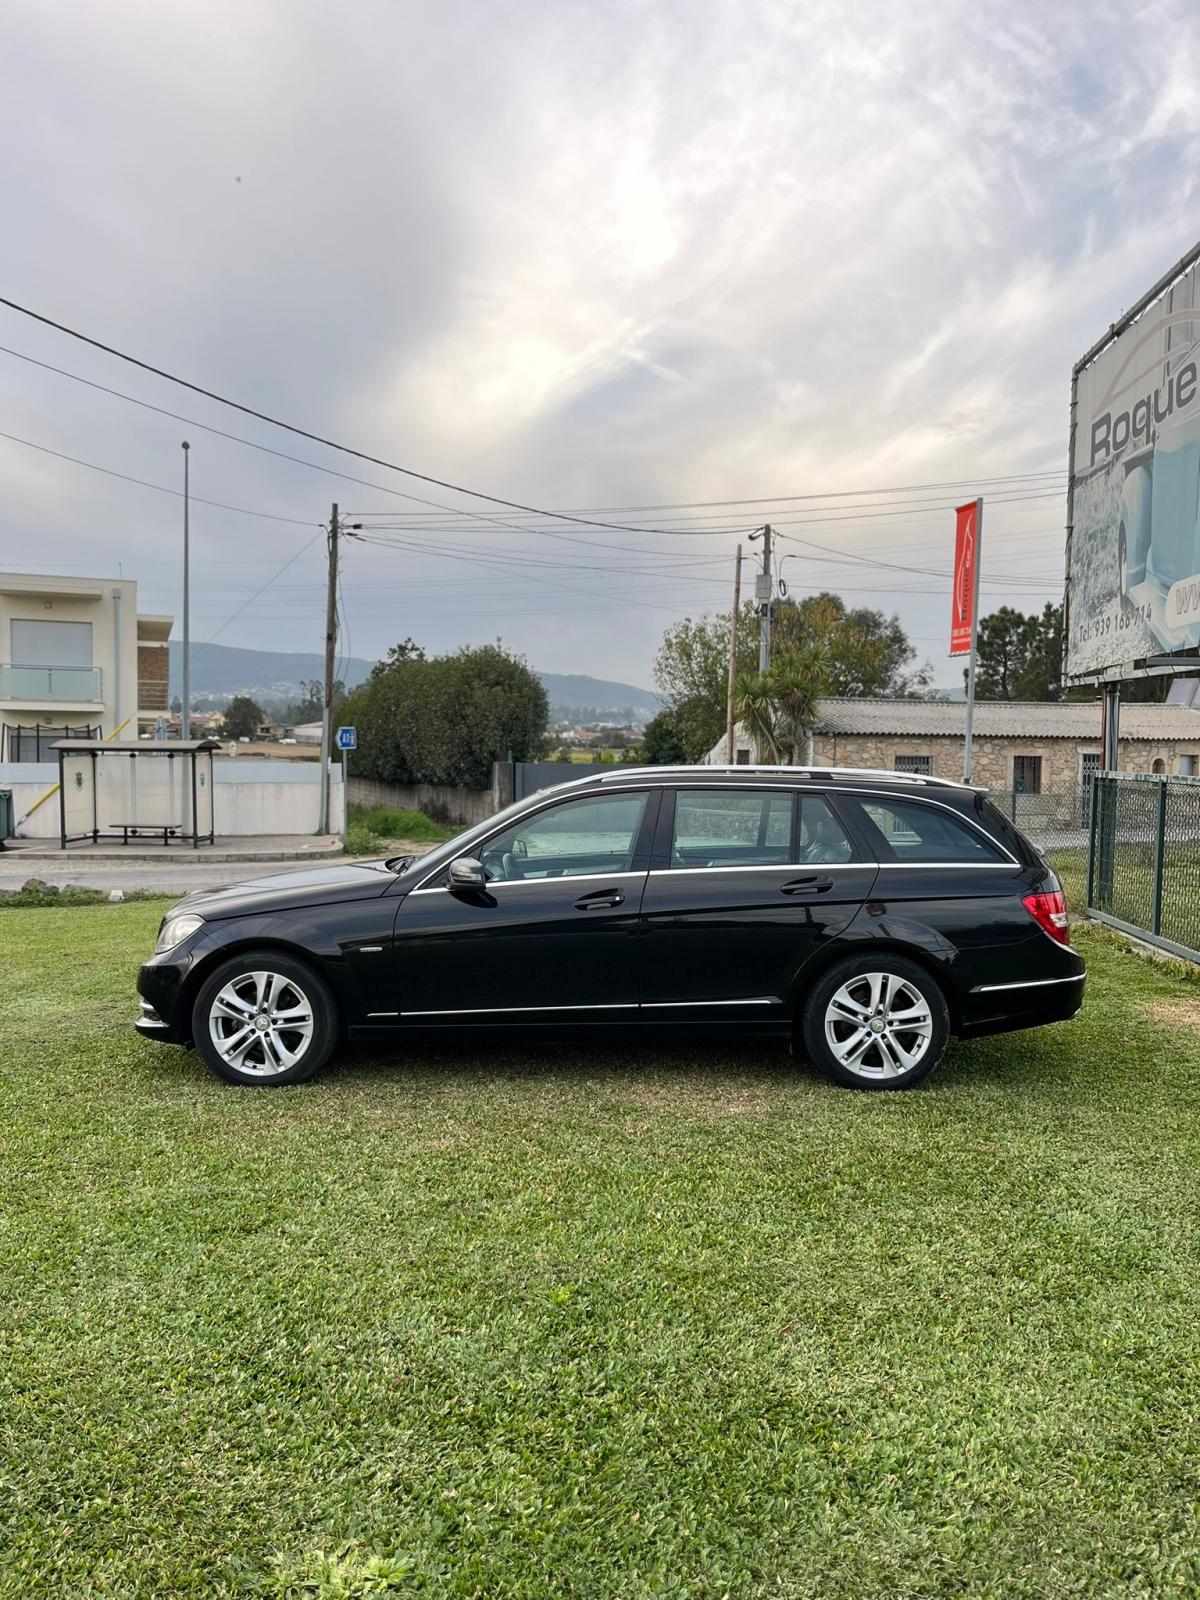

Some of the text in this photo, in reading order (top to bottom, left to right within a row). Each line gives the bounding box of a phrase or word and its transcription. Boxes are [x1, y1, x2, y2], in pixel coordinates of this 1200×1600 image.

[1090, 362, 1197, 467] Roque
[1095, 615, 1110, 637] 939
[1115, 613, 1130, 632] 166
[1134, 602, 1152, 625] 714
